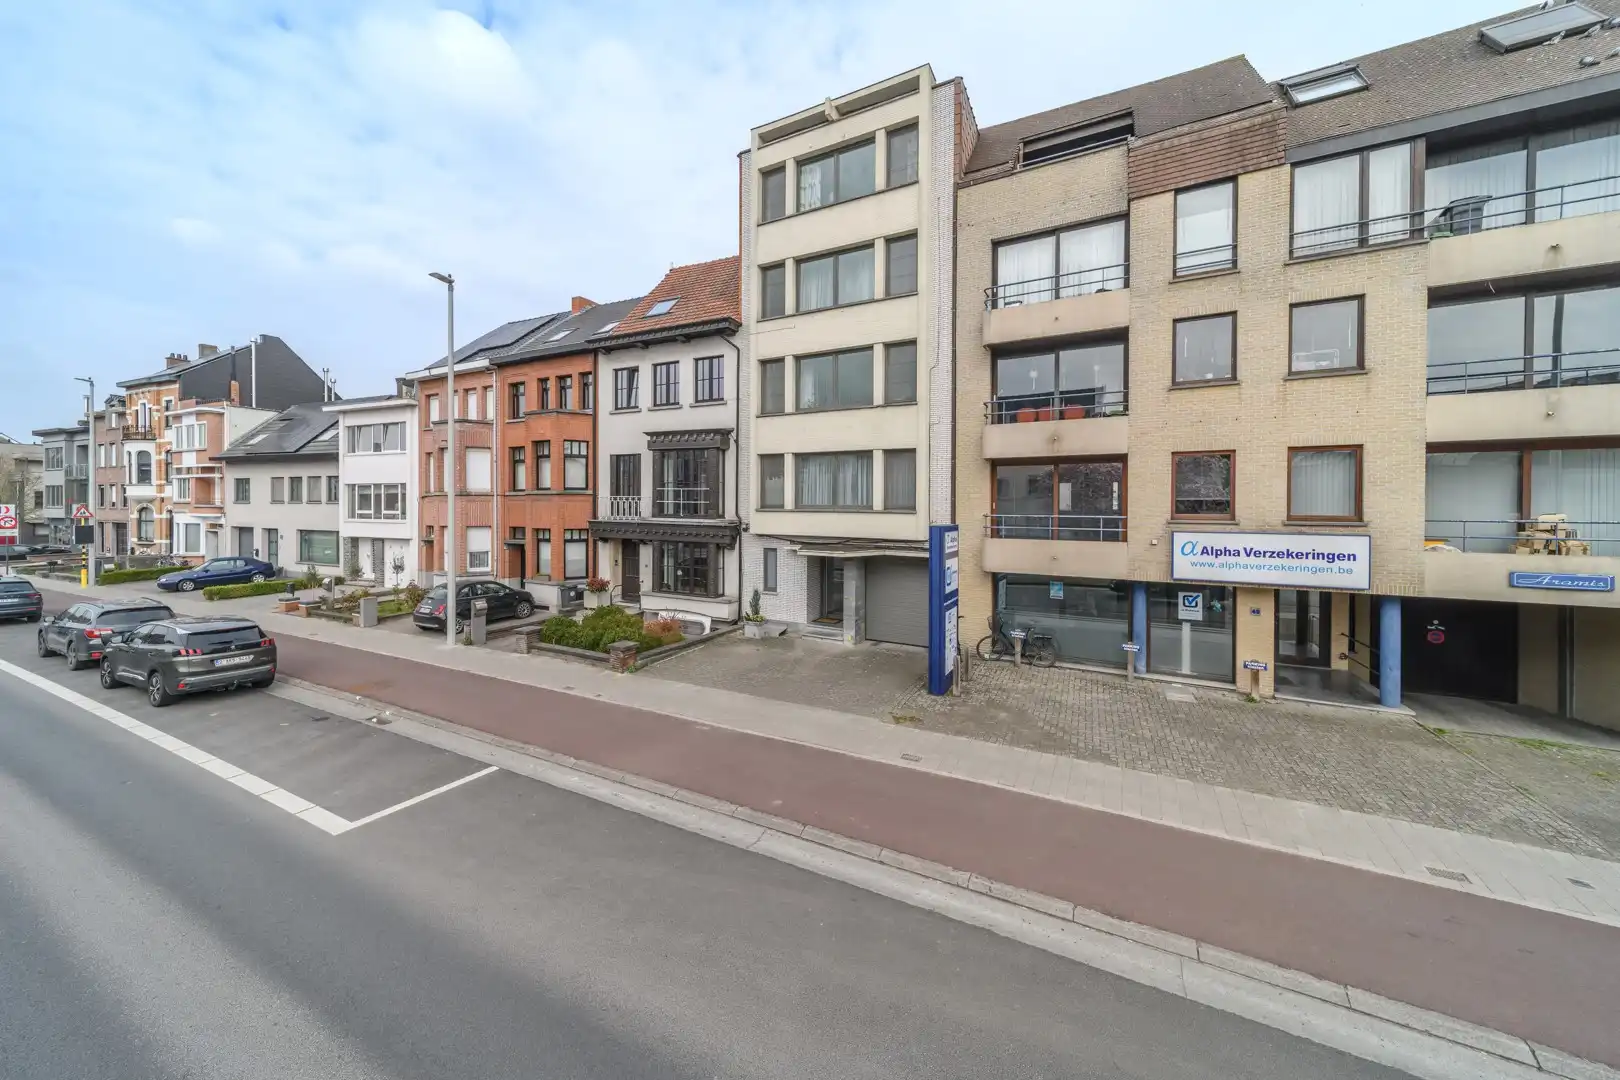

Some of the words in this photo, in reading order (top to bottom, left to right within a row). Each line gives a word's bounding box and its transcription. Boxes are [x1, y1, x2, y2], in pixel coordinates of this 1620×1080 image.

[1199, 545, 1241, 559] Alpha
[1243, 546, 1357, 564] Verzekeringen
[1190, 560, 1354, 575] www.alphaverzekeringen.be
[1517, 575, 1606, 588] Aramis
